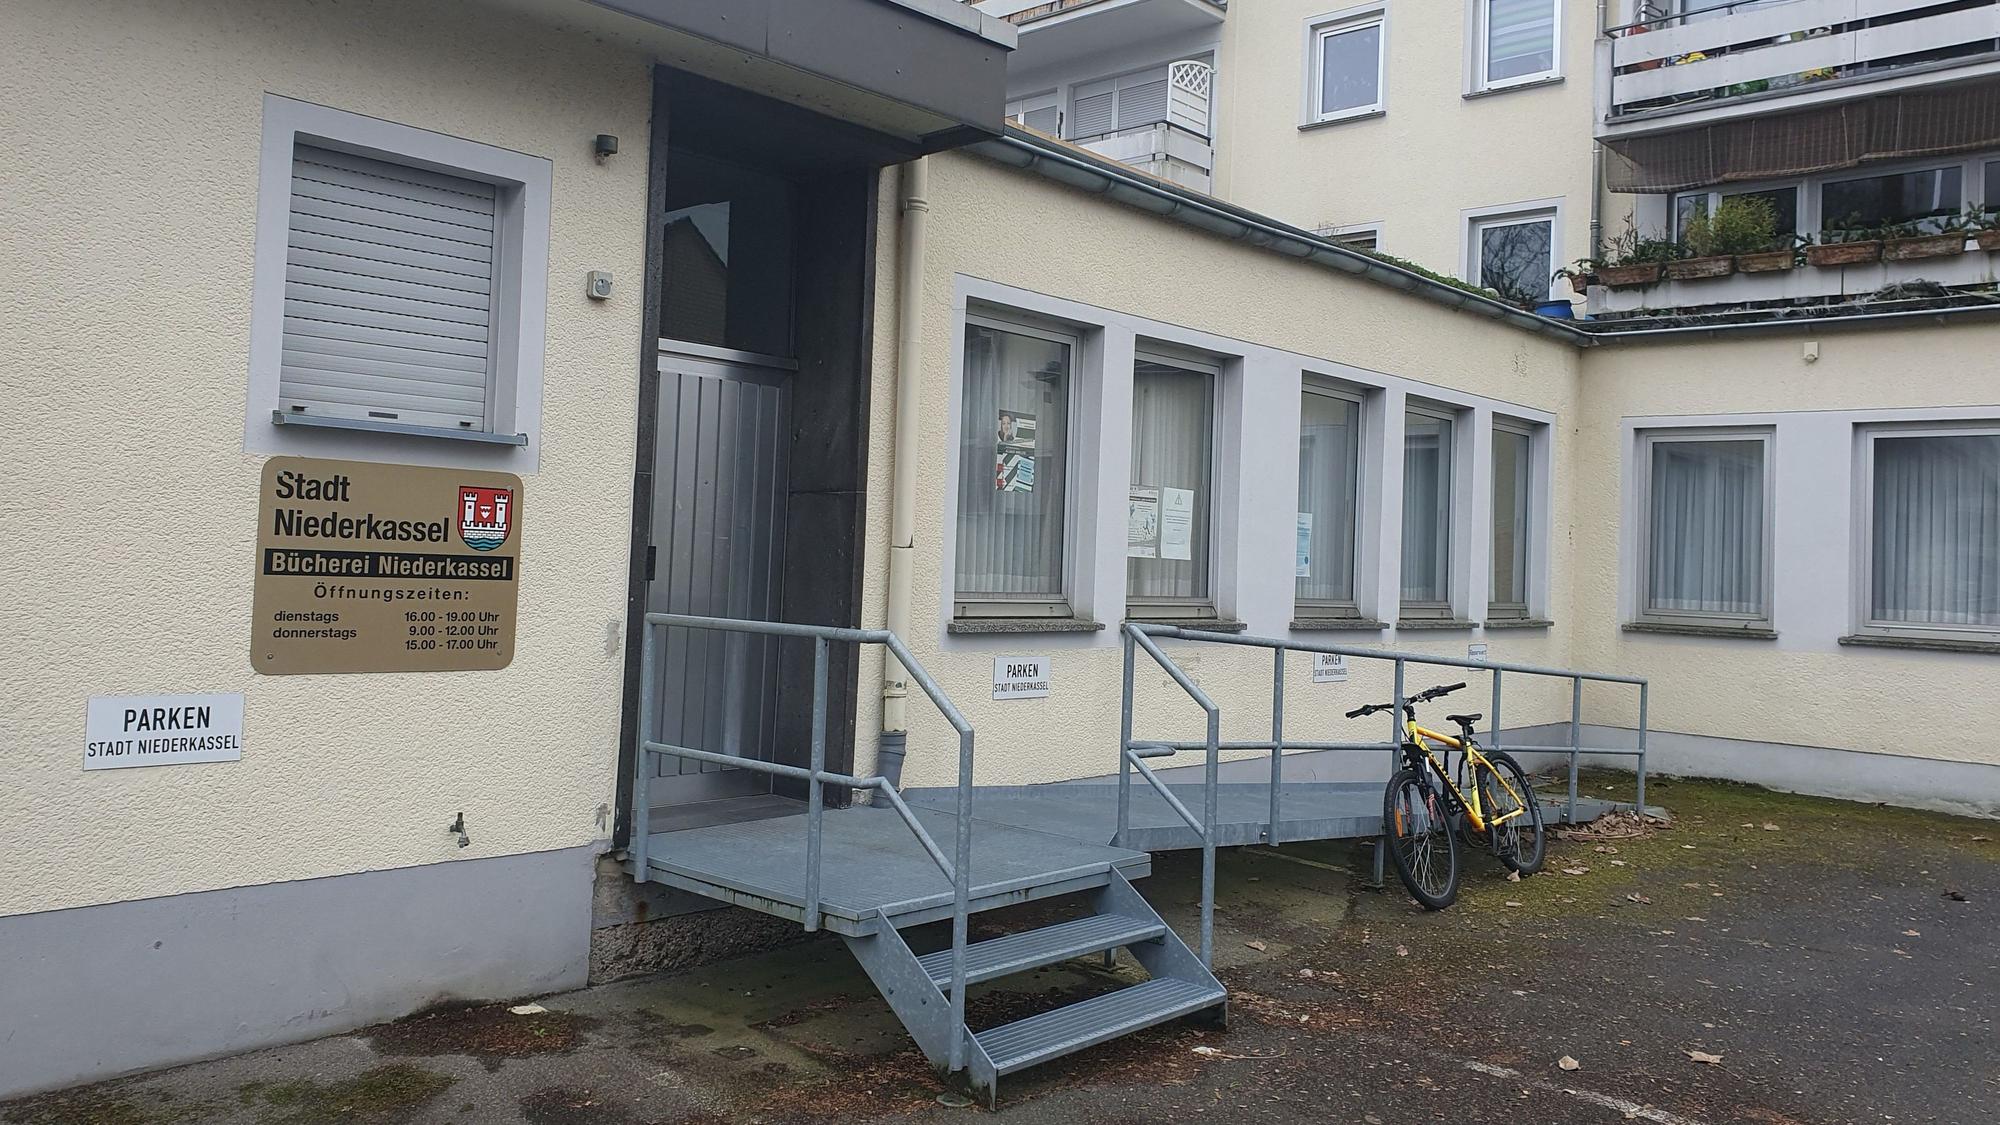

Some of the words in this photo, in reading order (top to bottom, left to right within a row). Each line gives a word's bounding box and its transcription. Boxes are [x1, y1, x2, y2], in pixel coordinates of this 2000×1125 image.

[276, 471, 350, 502] Stadt
[274, 508, 449, 542] Niederkassel
[271, 551, 370, 574] Bücherei
[378, 555, 508, 578] Niederkassel
[314, 581, 469, 602] Öffnungszeiten:
[274, 610, 339, 624] dienstags
[405, 612, 435, 622] 16.00
[446, 612, 476, 622] 19.00
[479, 612, 499, 622] Uhr
[273, 627, 357, 640] donnerstags
[409, 626, 435, 636] 9.00
[445, 626, 475, 636] 12.00
[478, 626, 499, 636] Uhr
[405, 640, 436, 650] 15.00
[446, 640, 474, 650] 17.00
[477, 639, 498, 650] Uhr
[1007, 663, 1039, 678] PARKEN
[995, 682, 1011, 692] STADT
[1011, 681, 1049, 692] NIEDERKASSEL
[123, 706, 211, 732] PARKEN
[87, 740, 134, 757] STADT
[138, 735, 240, 754] NIEDERKASSEL
